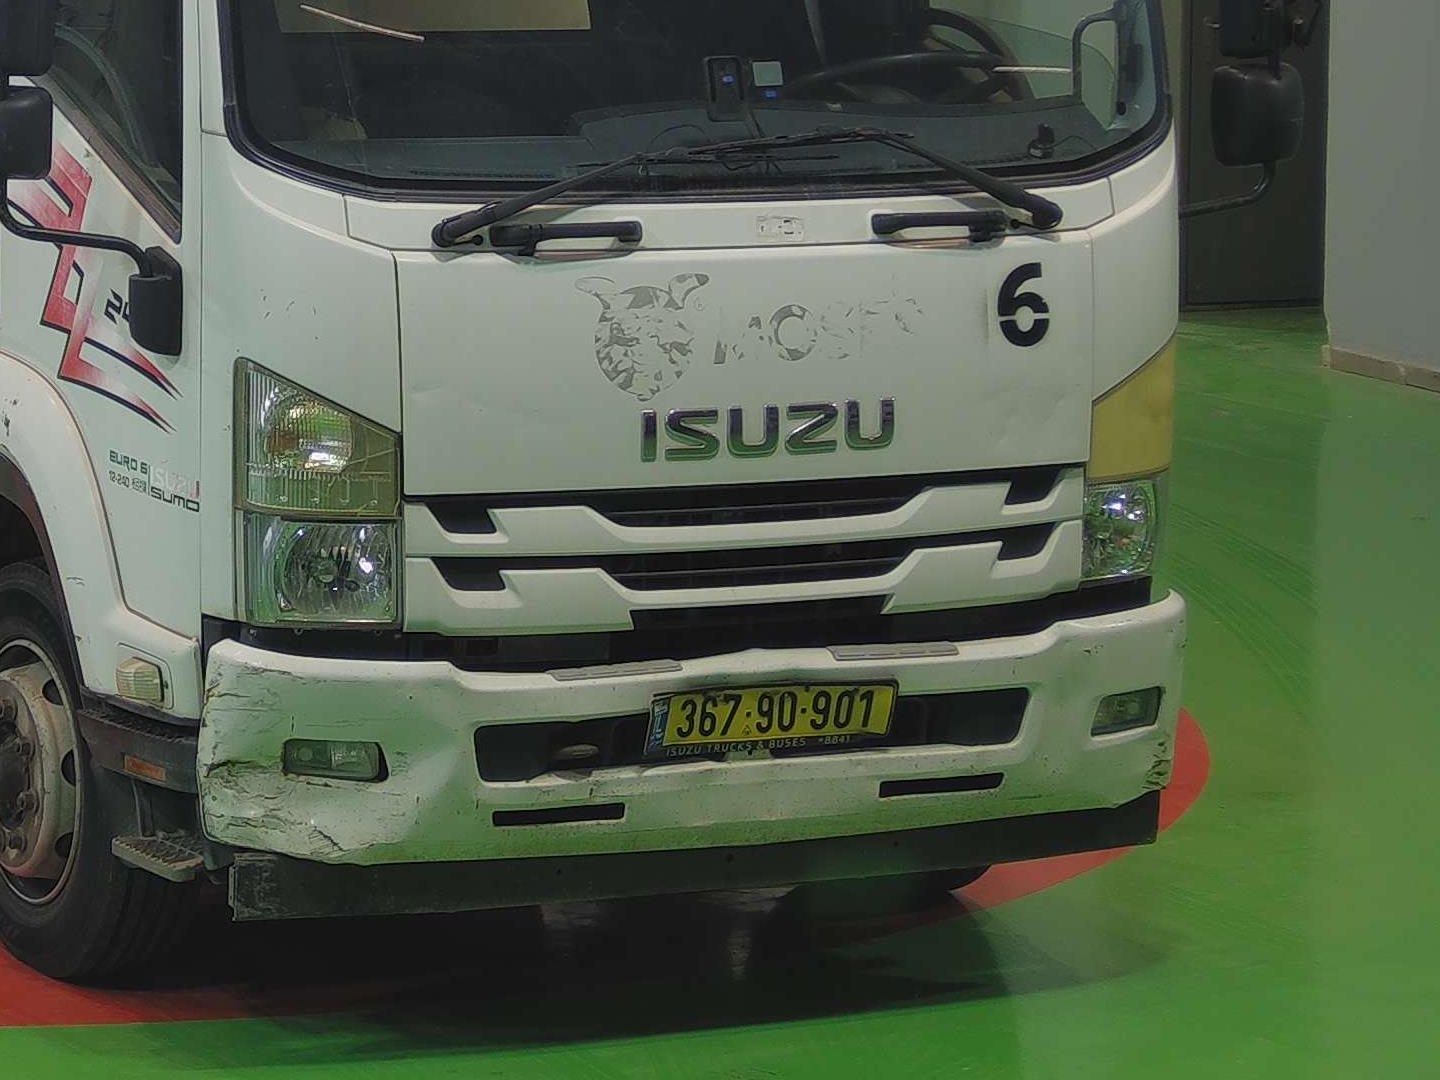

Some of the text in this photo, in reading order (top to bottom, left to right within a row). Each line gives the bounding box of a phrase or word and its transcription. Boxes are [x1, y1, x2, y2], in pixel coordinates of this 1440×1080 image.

[997, 261, 1050, 348] 6
[640, 395, 897, 463] ISUZU
[109, 449, 138, 472] EURO
[150, 486, 200, 513] SUMO
[666, 744, 702, 758] ISUZU
[707, 741, 753, 753] TRUCKS
[768, 737, 807, 749] BUSES
